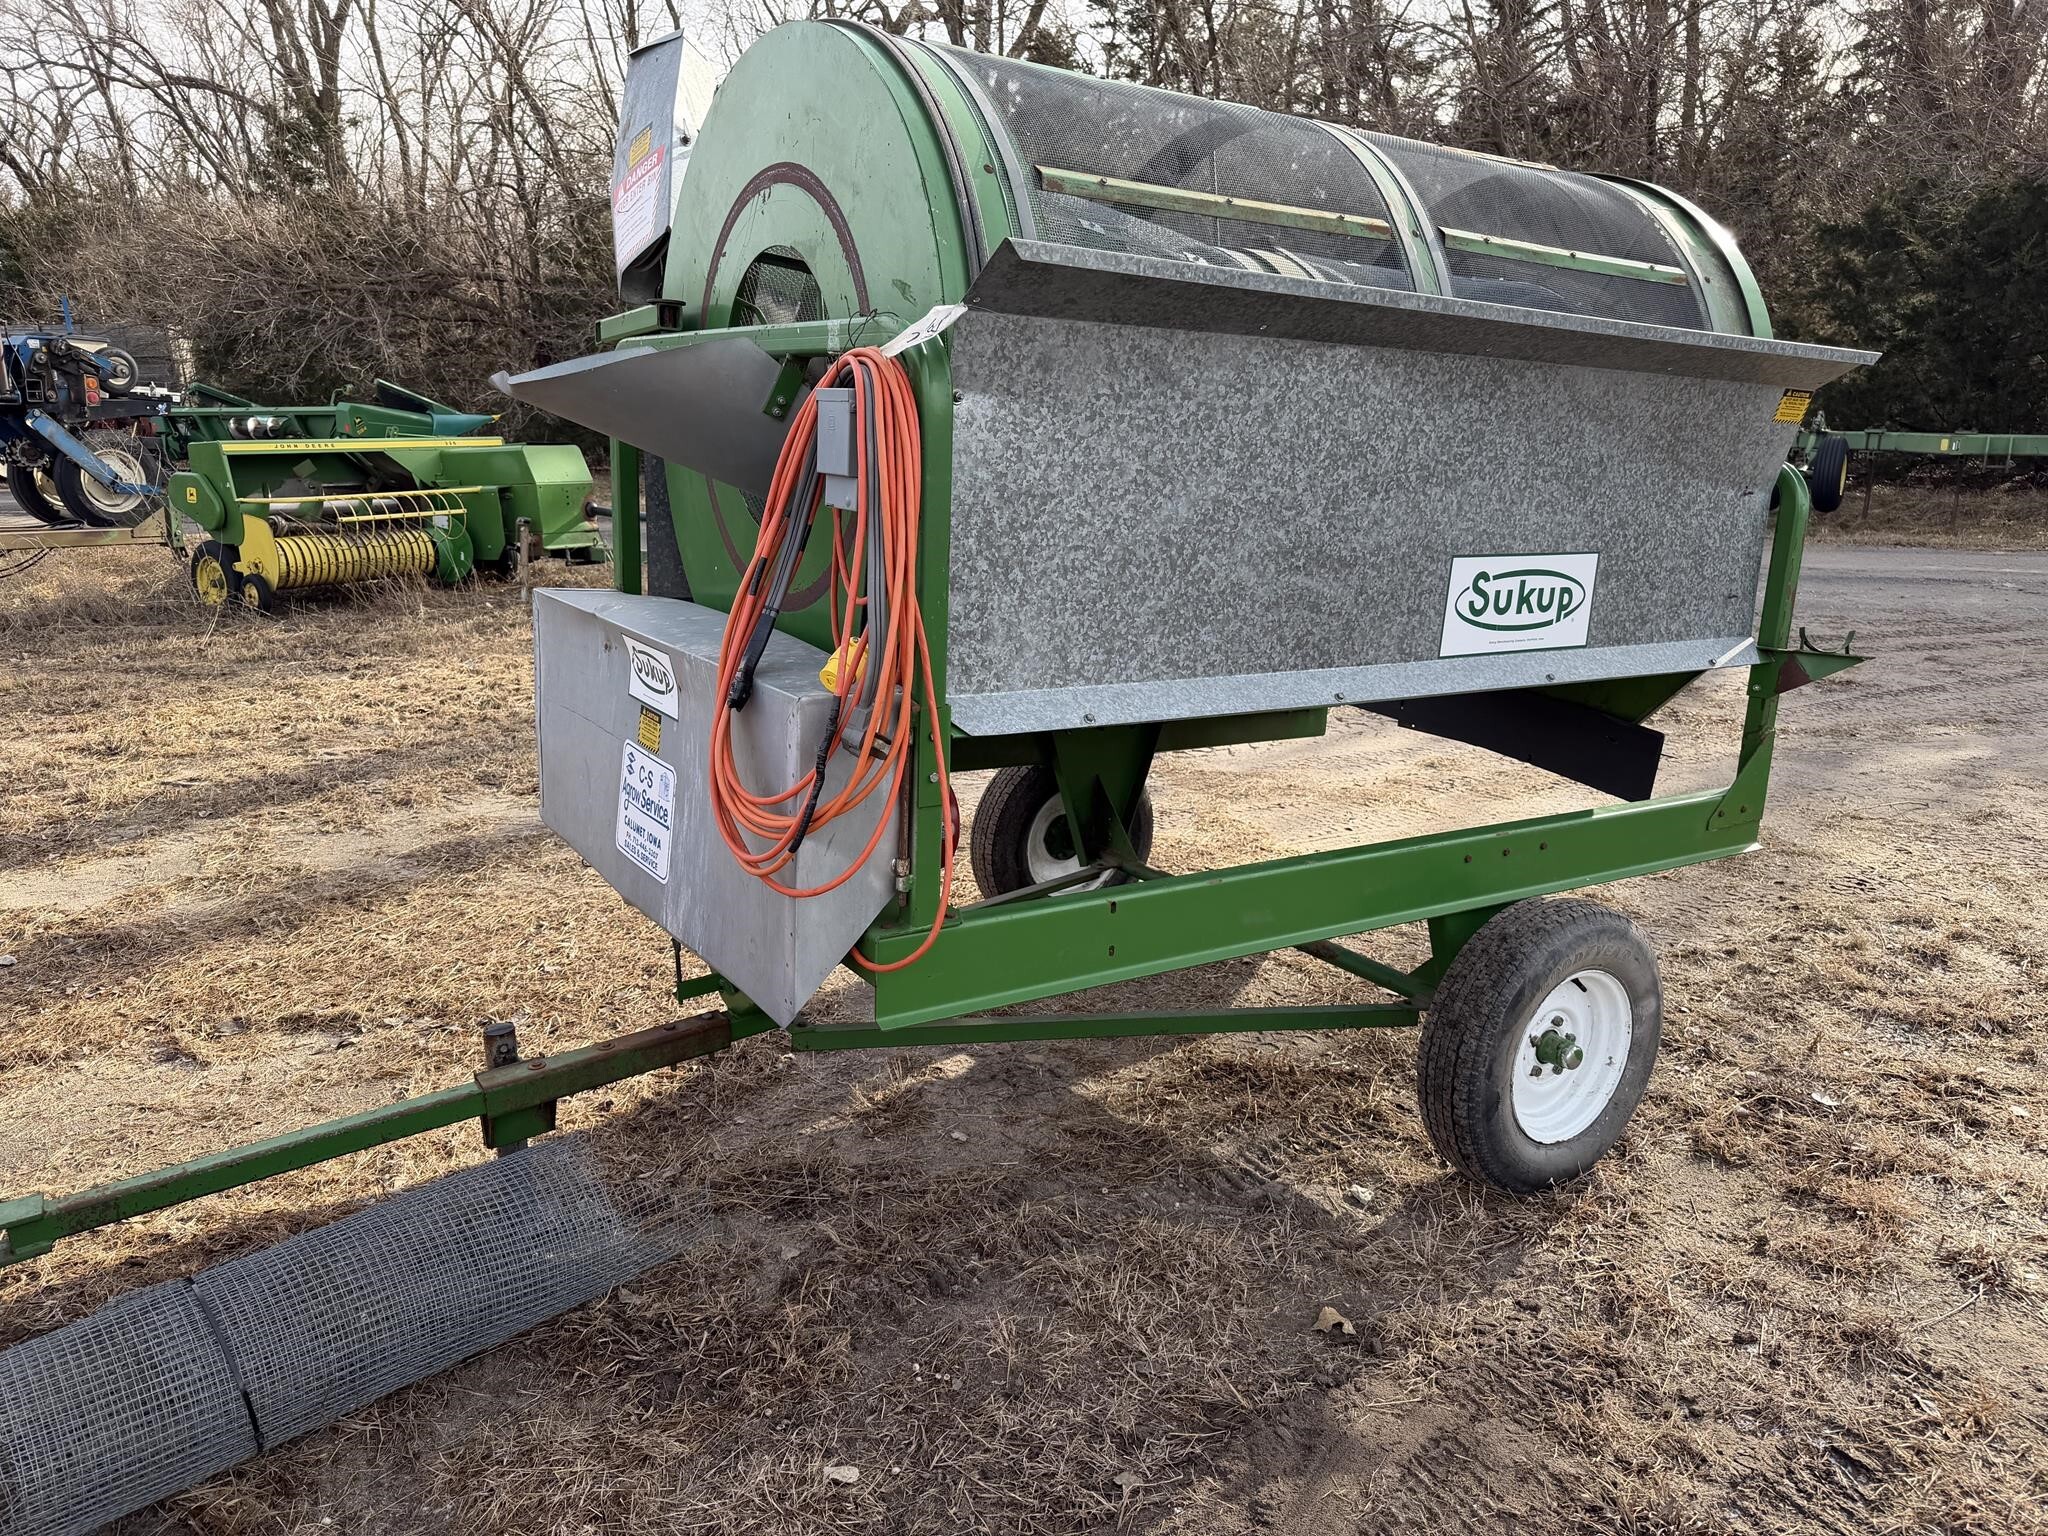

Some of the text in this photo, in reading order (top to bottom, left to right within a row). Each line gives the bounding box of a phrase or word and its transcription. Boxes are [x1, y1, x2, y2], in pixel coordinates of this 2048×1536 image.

[625, 152, 658, 191] DANGER
[1468, 570, 1574, 624] Sukup
[632, 645, 671, 695] Sukup
[638, 765, 654, 789] C-S
[641, 788, 669, 823] Service
[646, 831, 662, 851] IOWA
